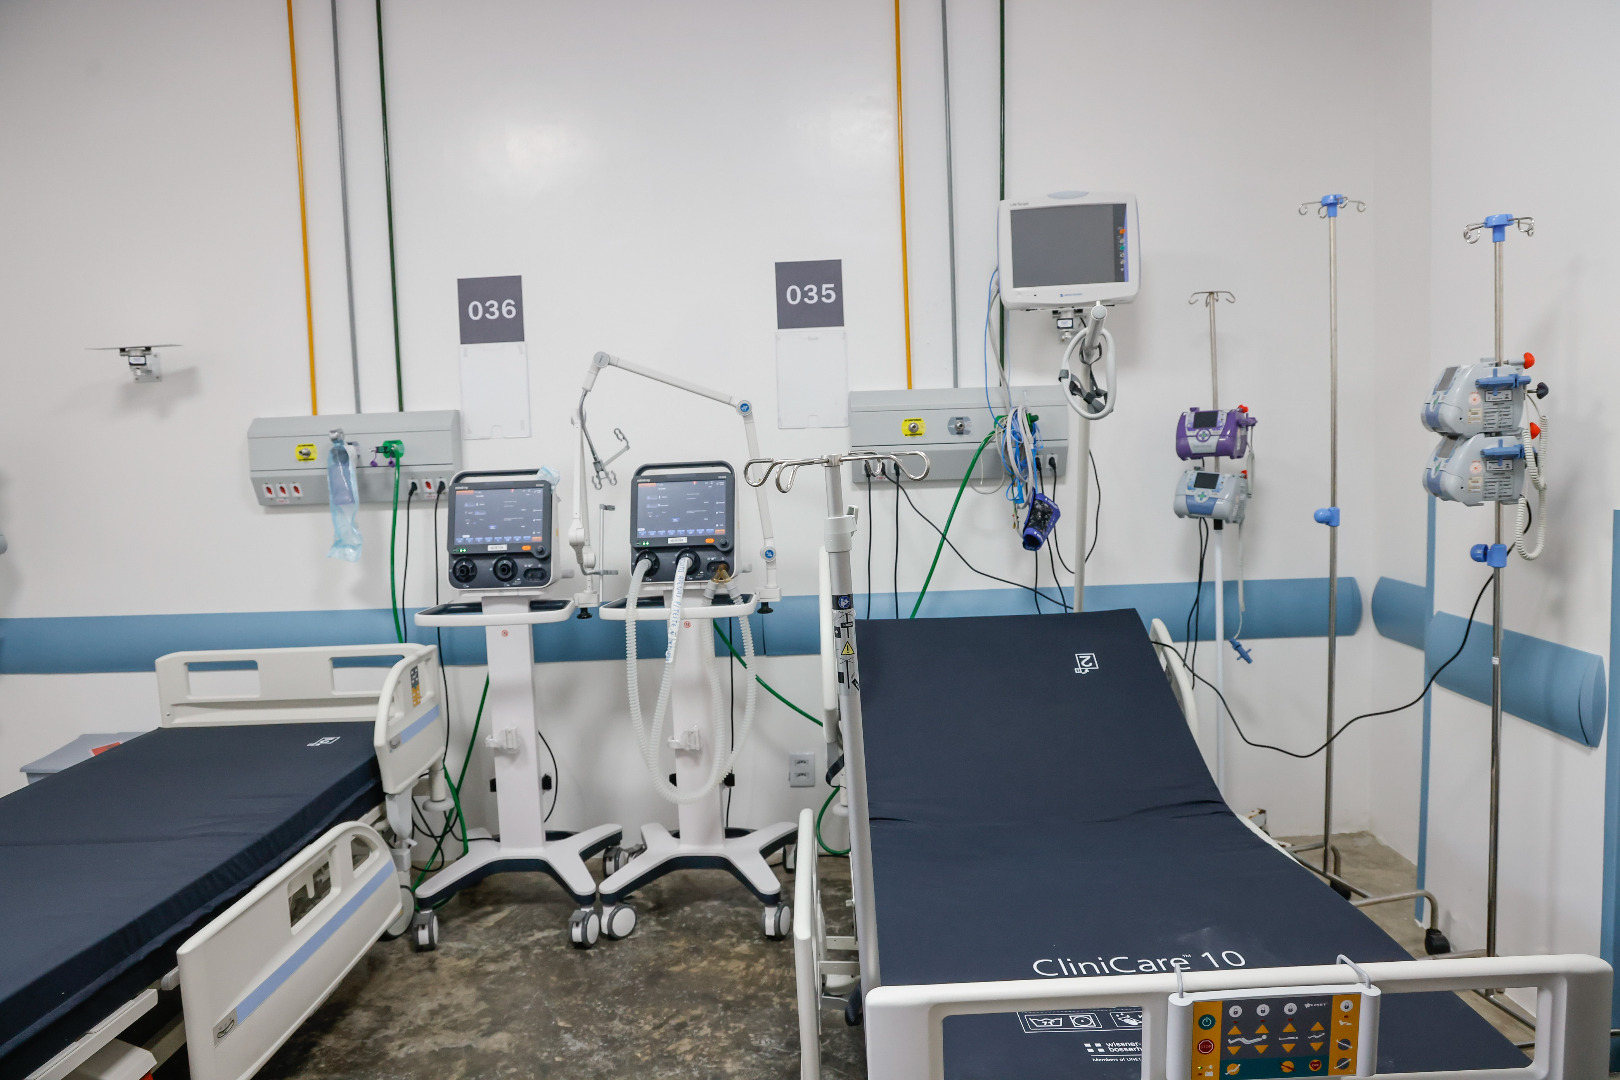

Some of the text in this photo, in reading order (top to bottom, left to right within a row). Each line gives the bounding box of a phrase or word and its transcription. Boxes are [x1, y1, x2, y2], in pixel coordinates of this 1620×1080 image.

[786, 283, 837, 306] 035
[468, 299, 517, 321] 036
[1201, 950, 1246, 968] 10
